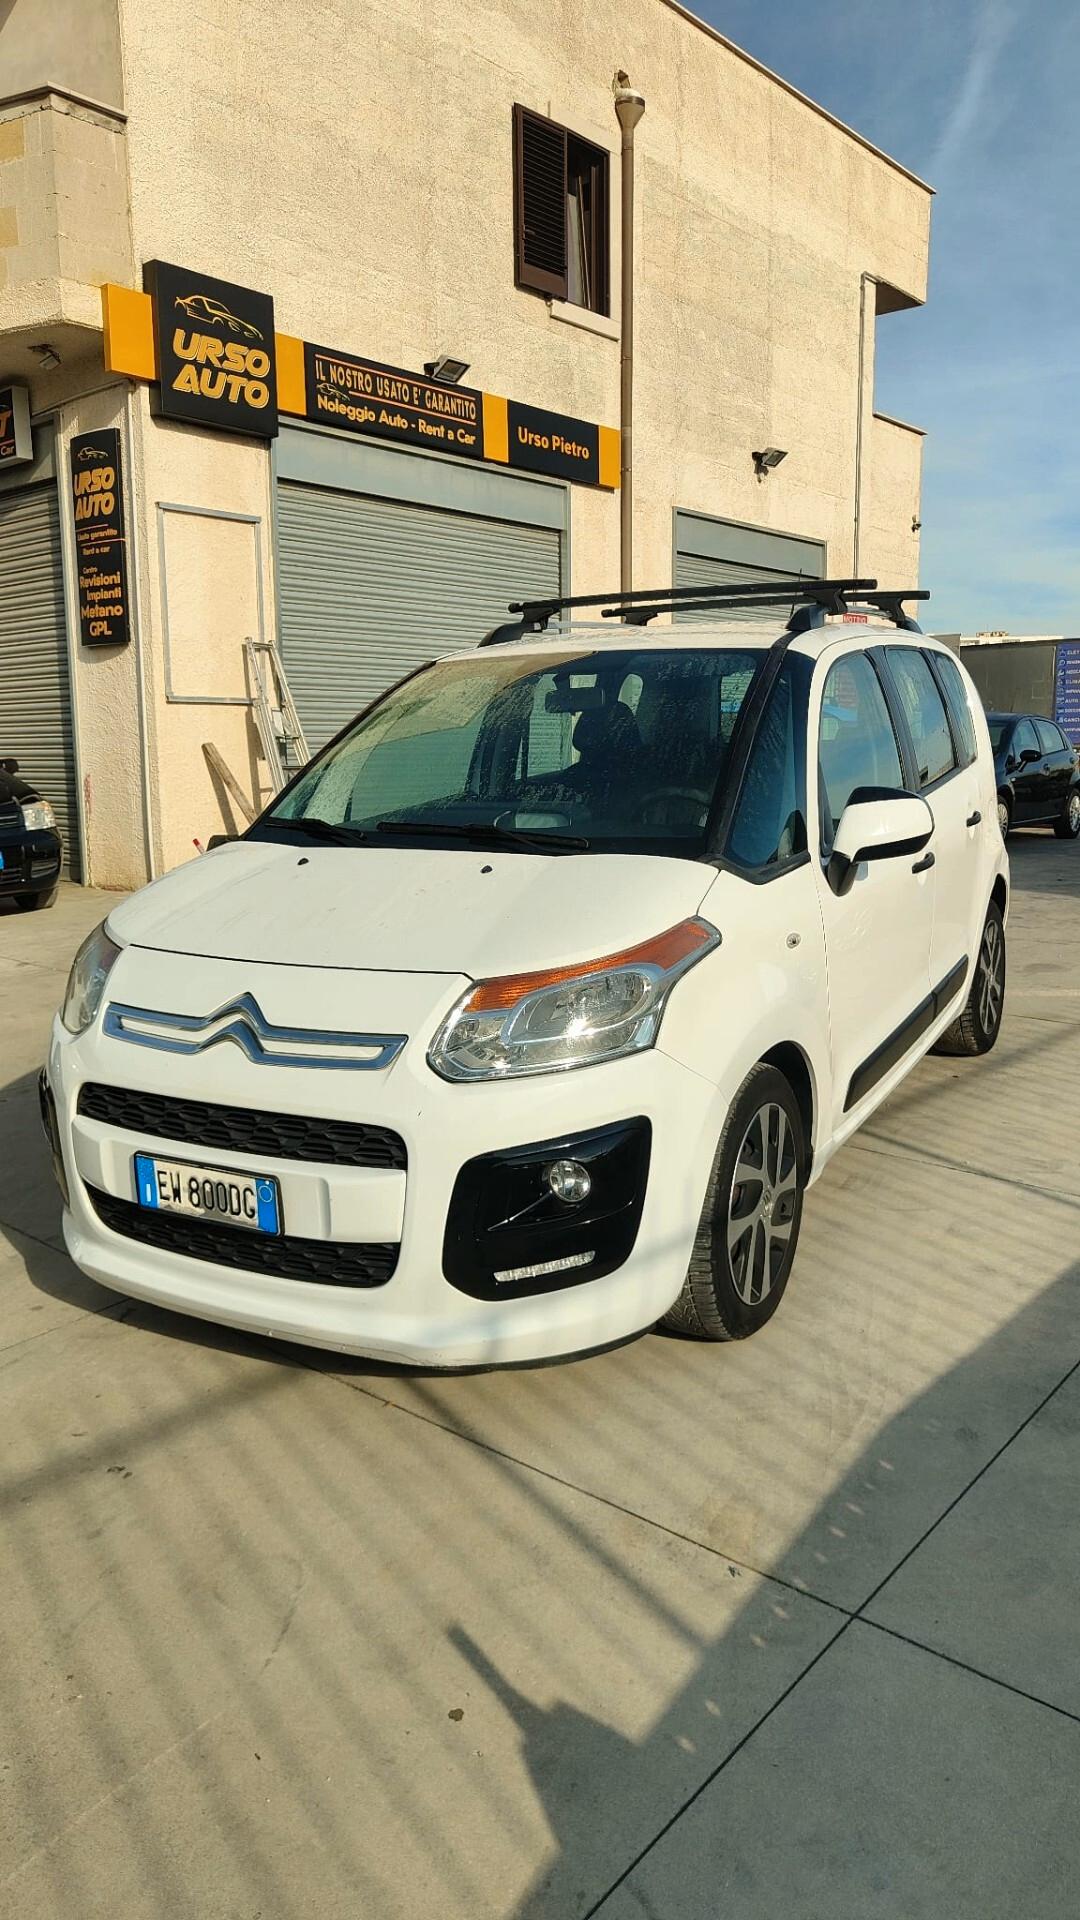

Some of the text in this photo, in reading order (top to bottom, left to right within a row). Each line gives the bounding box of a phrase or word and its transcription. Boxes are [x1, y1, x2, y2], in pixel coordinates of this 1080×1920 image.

[173, 328, 270, 378] URSO
[172, 364, 269, 409] AUTO
[315, 360, 477, 420] IL NOSTRO USATO E' GARANTITO
[317, 395, 376, 422] Noleggio
[378, 409, 408, 429] Auto
[418, 418, 445, 438] Rent
[447, 431, 454, 440] a
[456, 428, 477, 445] Car
[518, 426, 590, 459] Urso Pietro
[74, 467, 115, 496] URSO
[75, 492, 115, 521] AUTO
[80, 571, 121, 588] Revisioni
[87, 587, 121, 602] Impianti
[81, 604, 124, 619] Metano
[89, 620, 112, 636] GPL
[157, 1170, 256, 1219] EW 800DG
